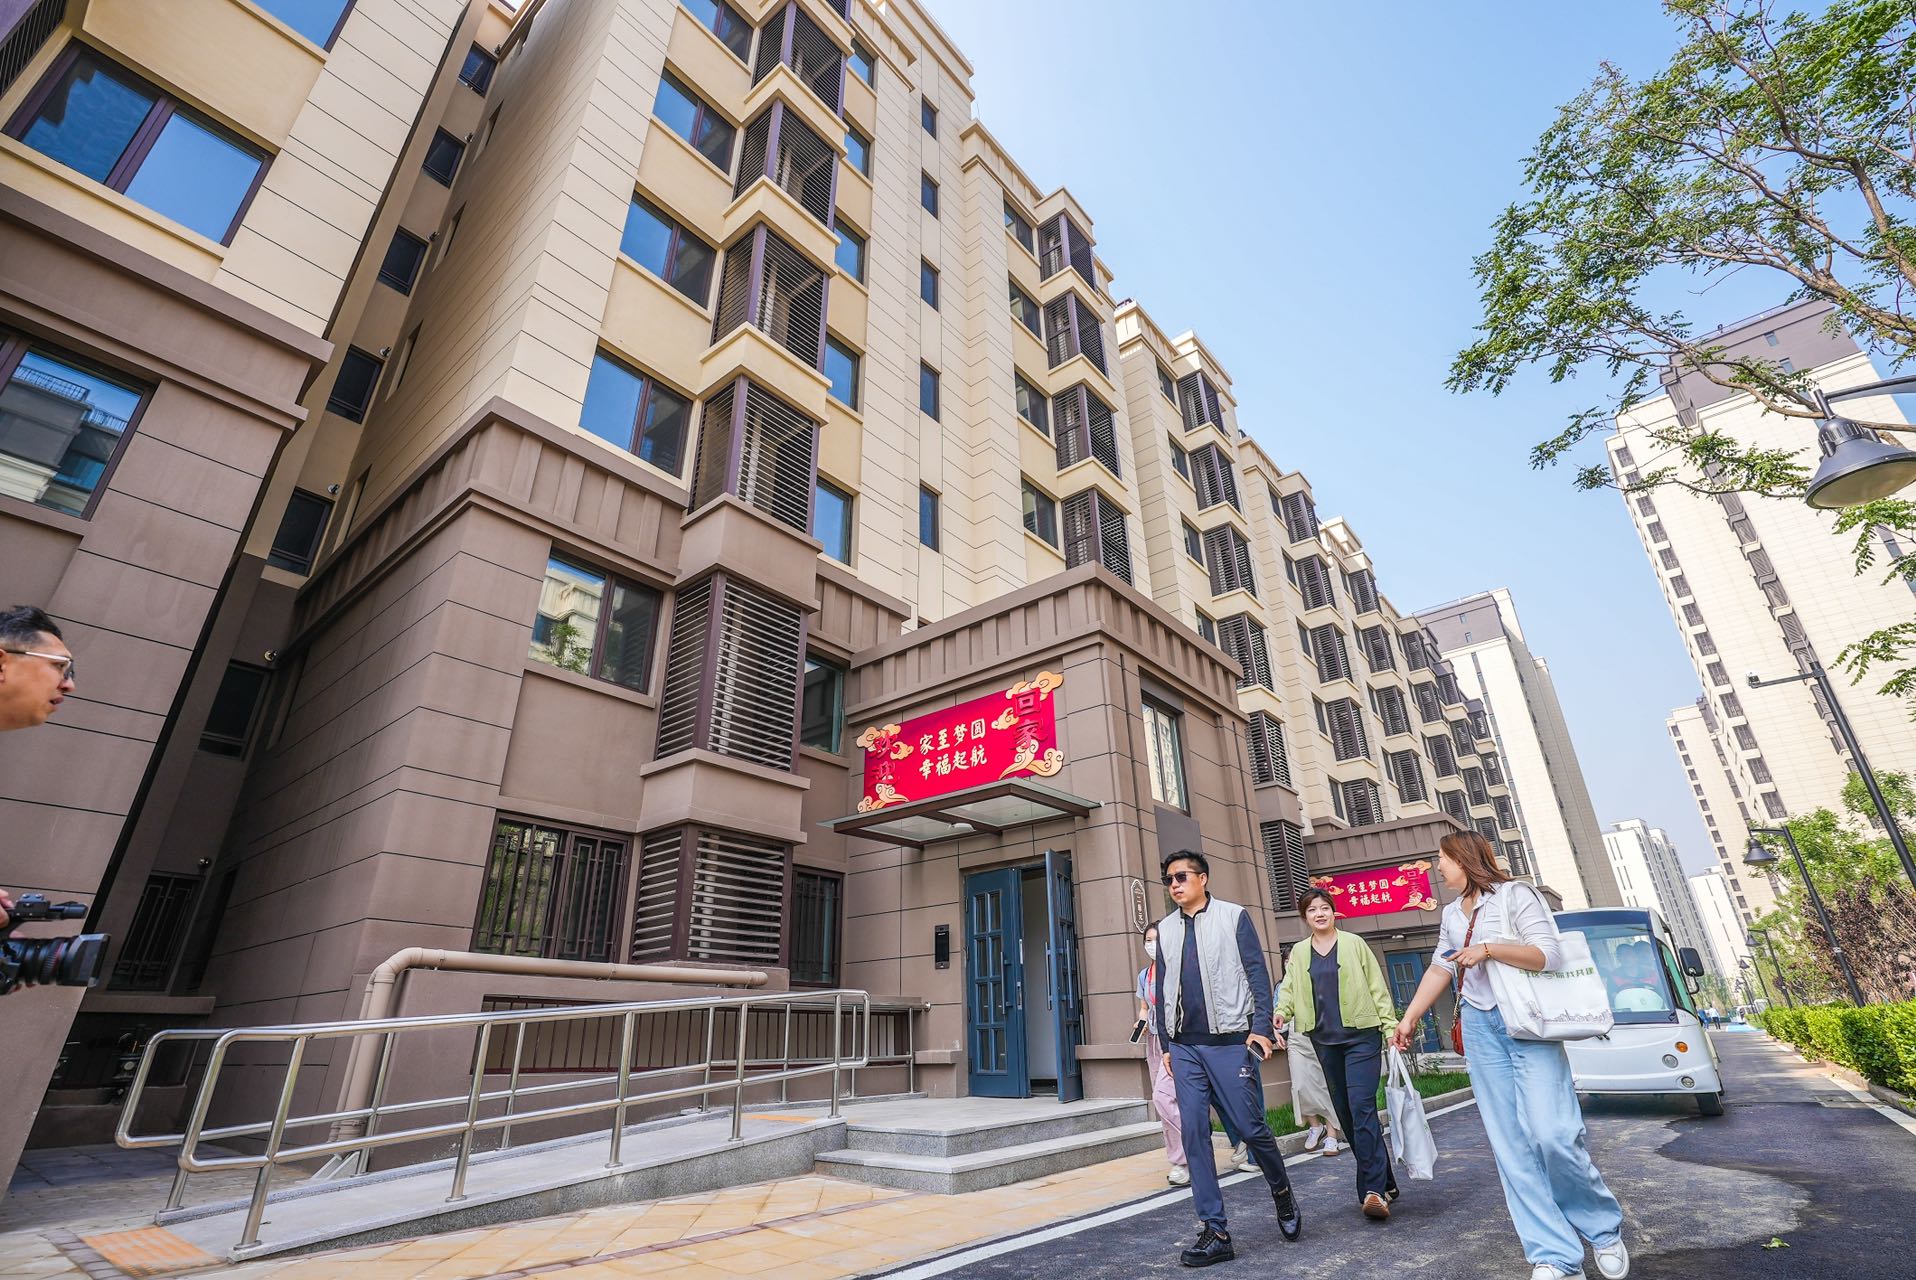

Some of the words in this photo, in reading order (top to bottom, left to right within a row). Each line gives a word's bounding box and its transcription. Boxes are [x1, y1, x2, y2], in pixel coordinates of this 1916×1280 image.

[1012, 688, 1047, 748] 回家
[919, 718, 986, 755] 家至梦圆
[919, 744, 987, 780] 幸福起航
[1346, 878, 1390, 894] 家至梦圆
[1349, 892, 1393, 907] 幸福起航
